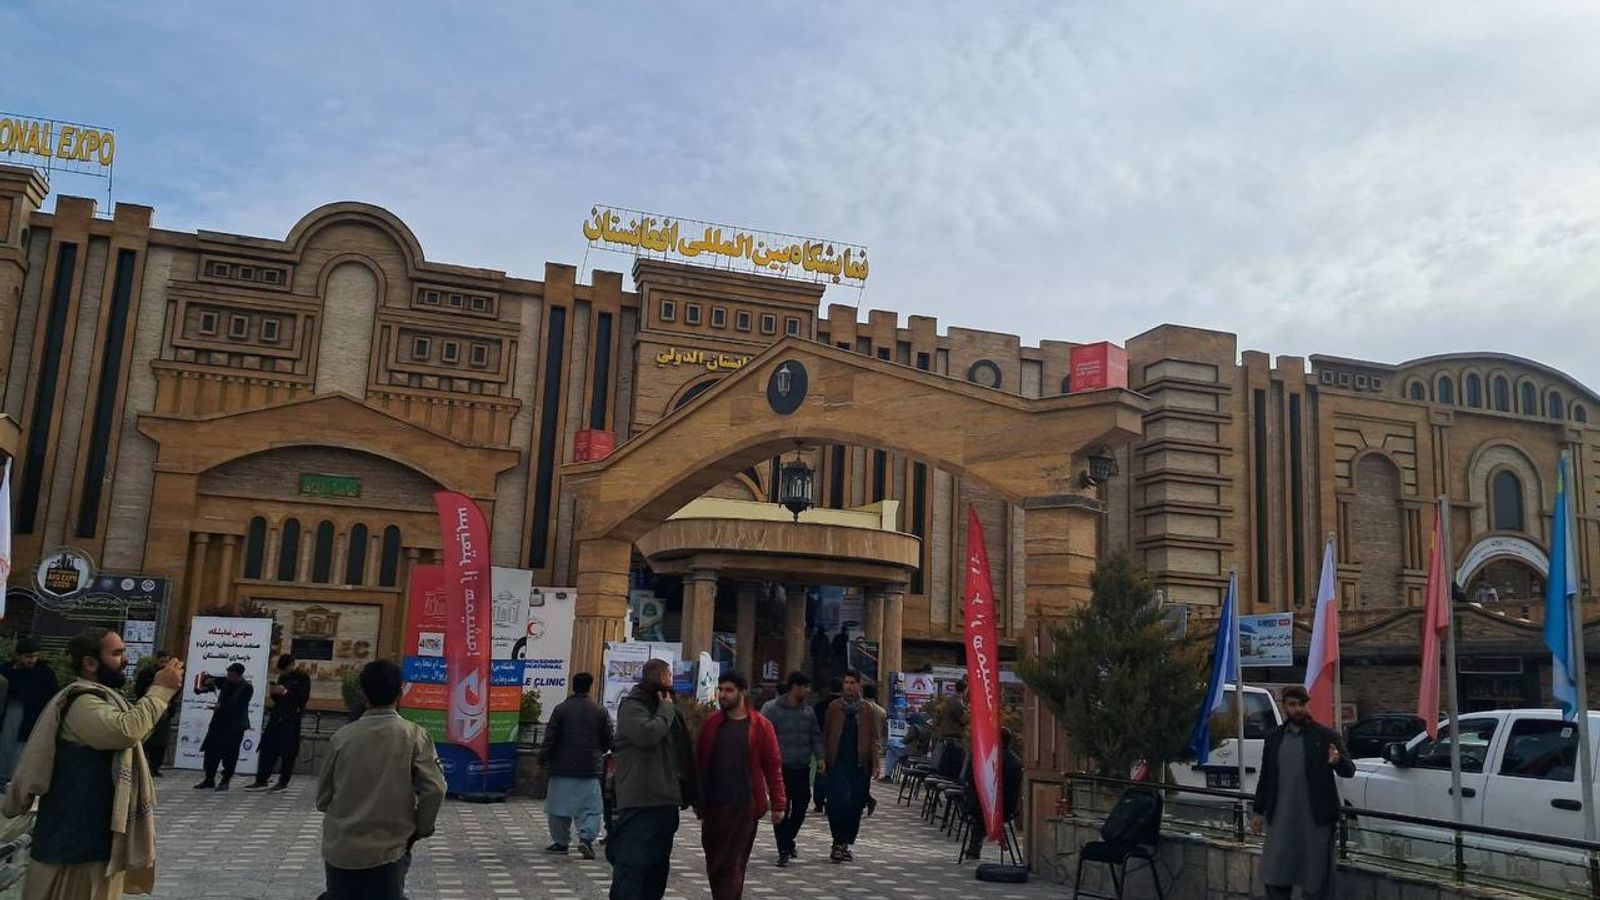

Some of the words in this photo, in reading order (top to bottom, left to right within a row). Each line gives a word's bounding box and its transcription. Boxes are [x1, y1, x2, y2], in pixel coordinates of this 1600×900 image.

[56, 126, 115, 166] EXPO
[583, 206, 678, 253] افغانستان
[678, 227, 753, 260] المللی
[752, 241, 791, 272] بین
[788, 241, 869, 284] نمایشگاه
[706, 353, 752, 371] انستان
[533, 678, 565, 687] CLINIC
